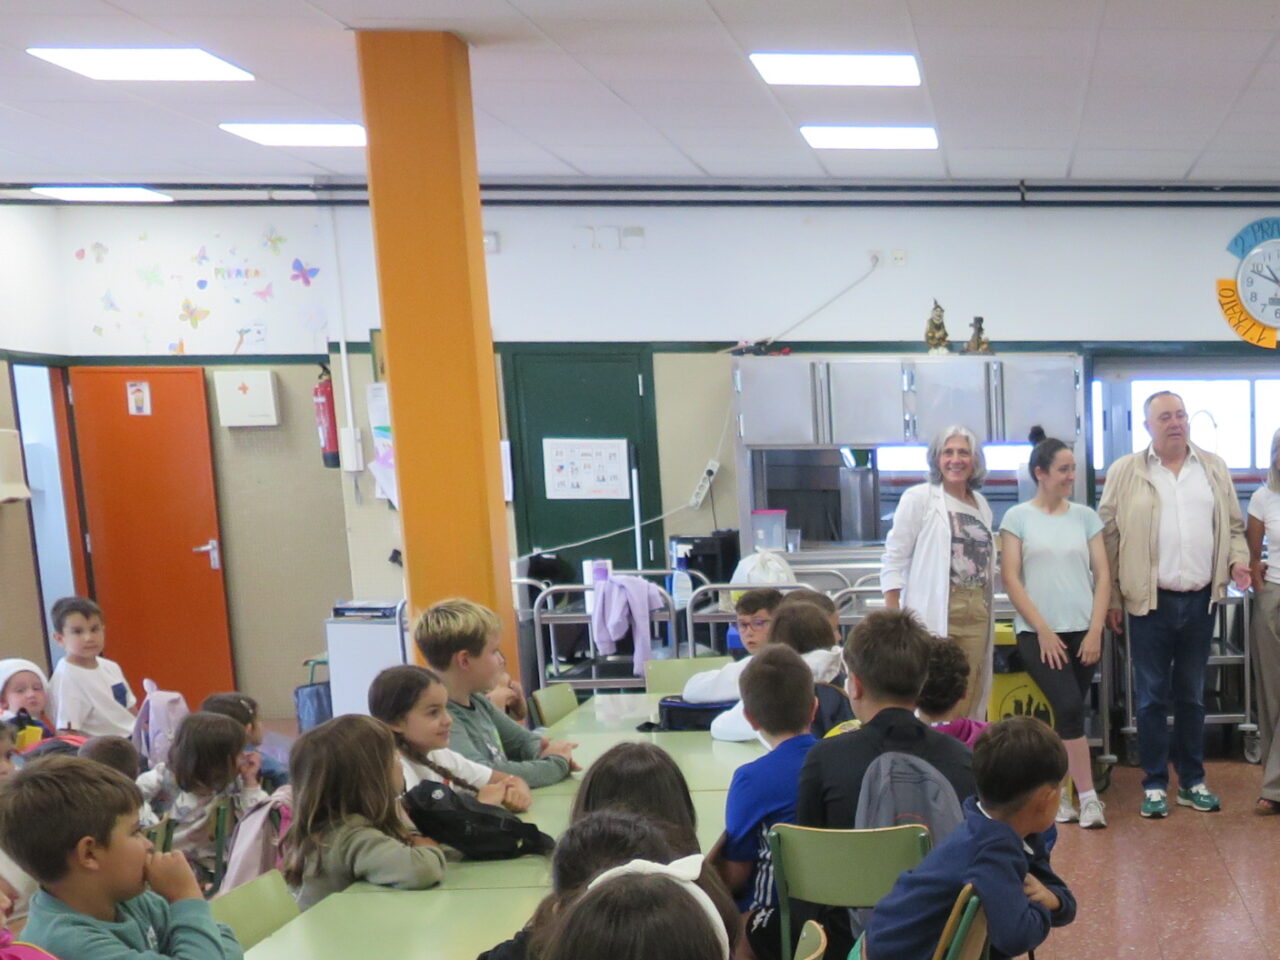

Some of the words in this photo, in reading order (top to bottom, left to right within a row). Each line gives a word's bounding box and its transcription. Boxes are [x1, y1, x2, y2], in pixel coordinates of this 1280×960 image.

[1246, 276, 1254, 287] 9
[1249, 291, 1258, 303] 8
[1218, 287, 1256, 337] PRATO
[1260, 303, 1268, 313] 7
